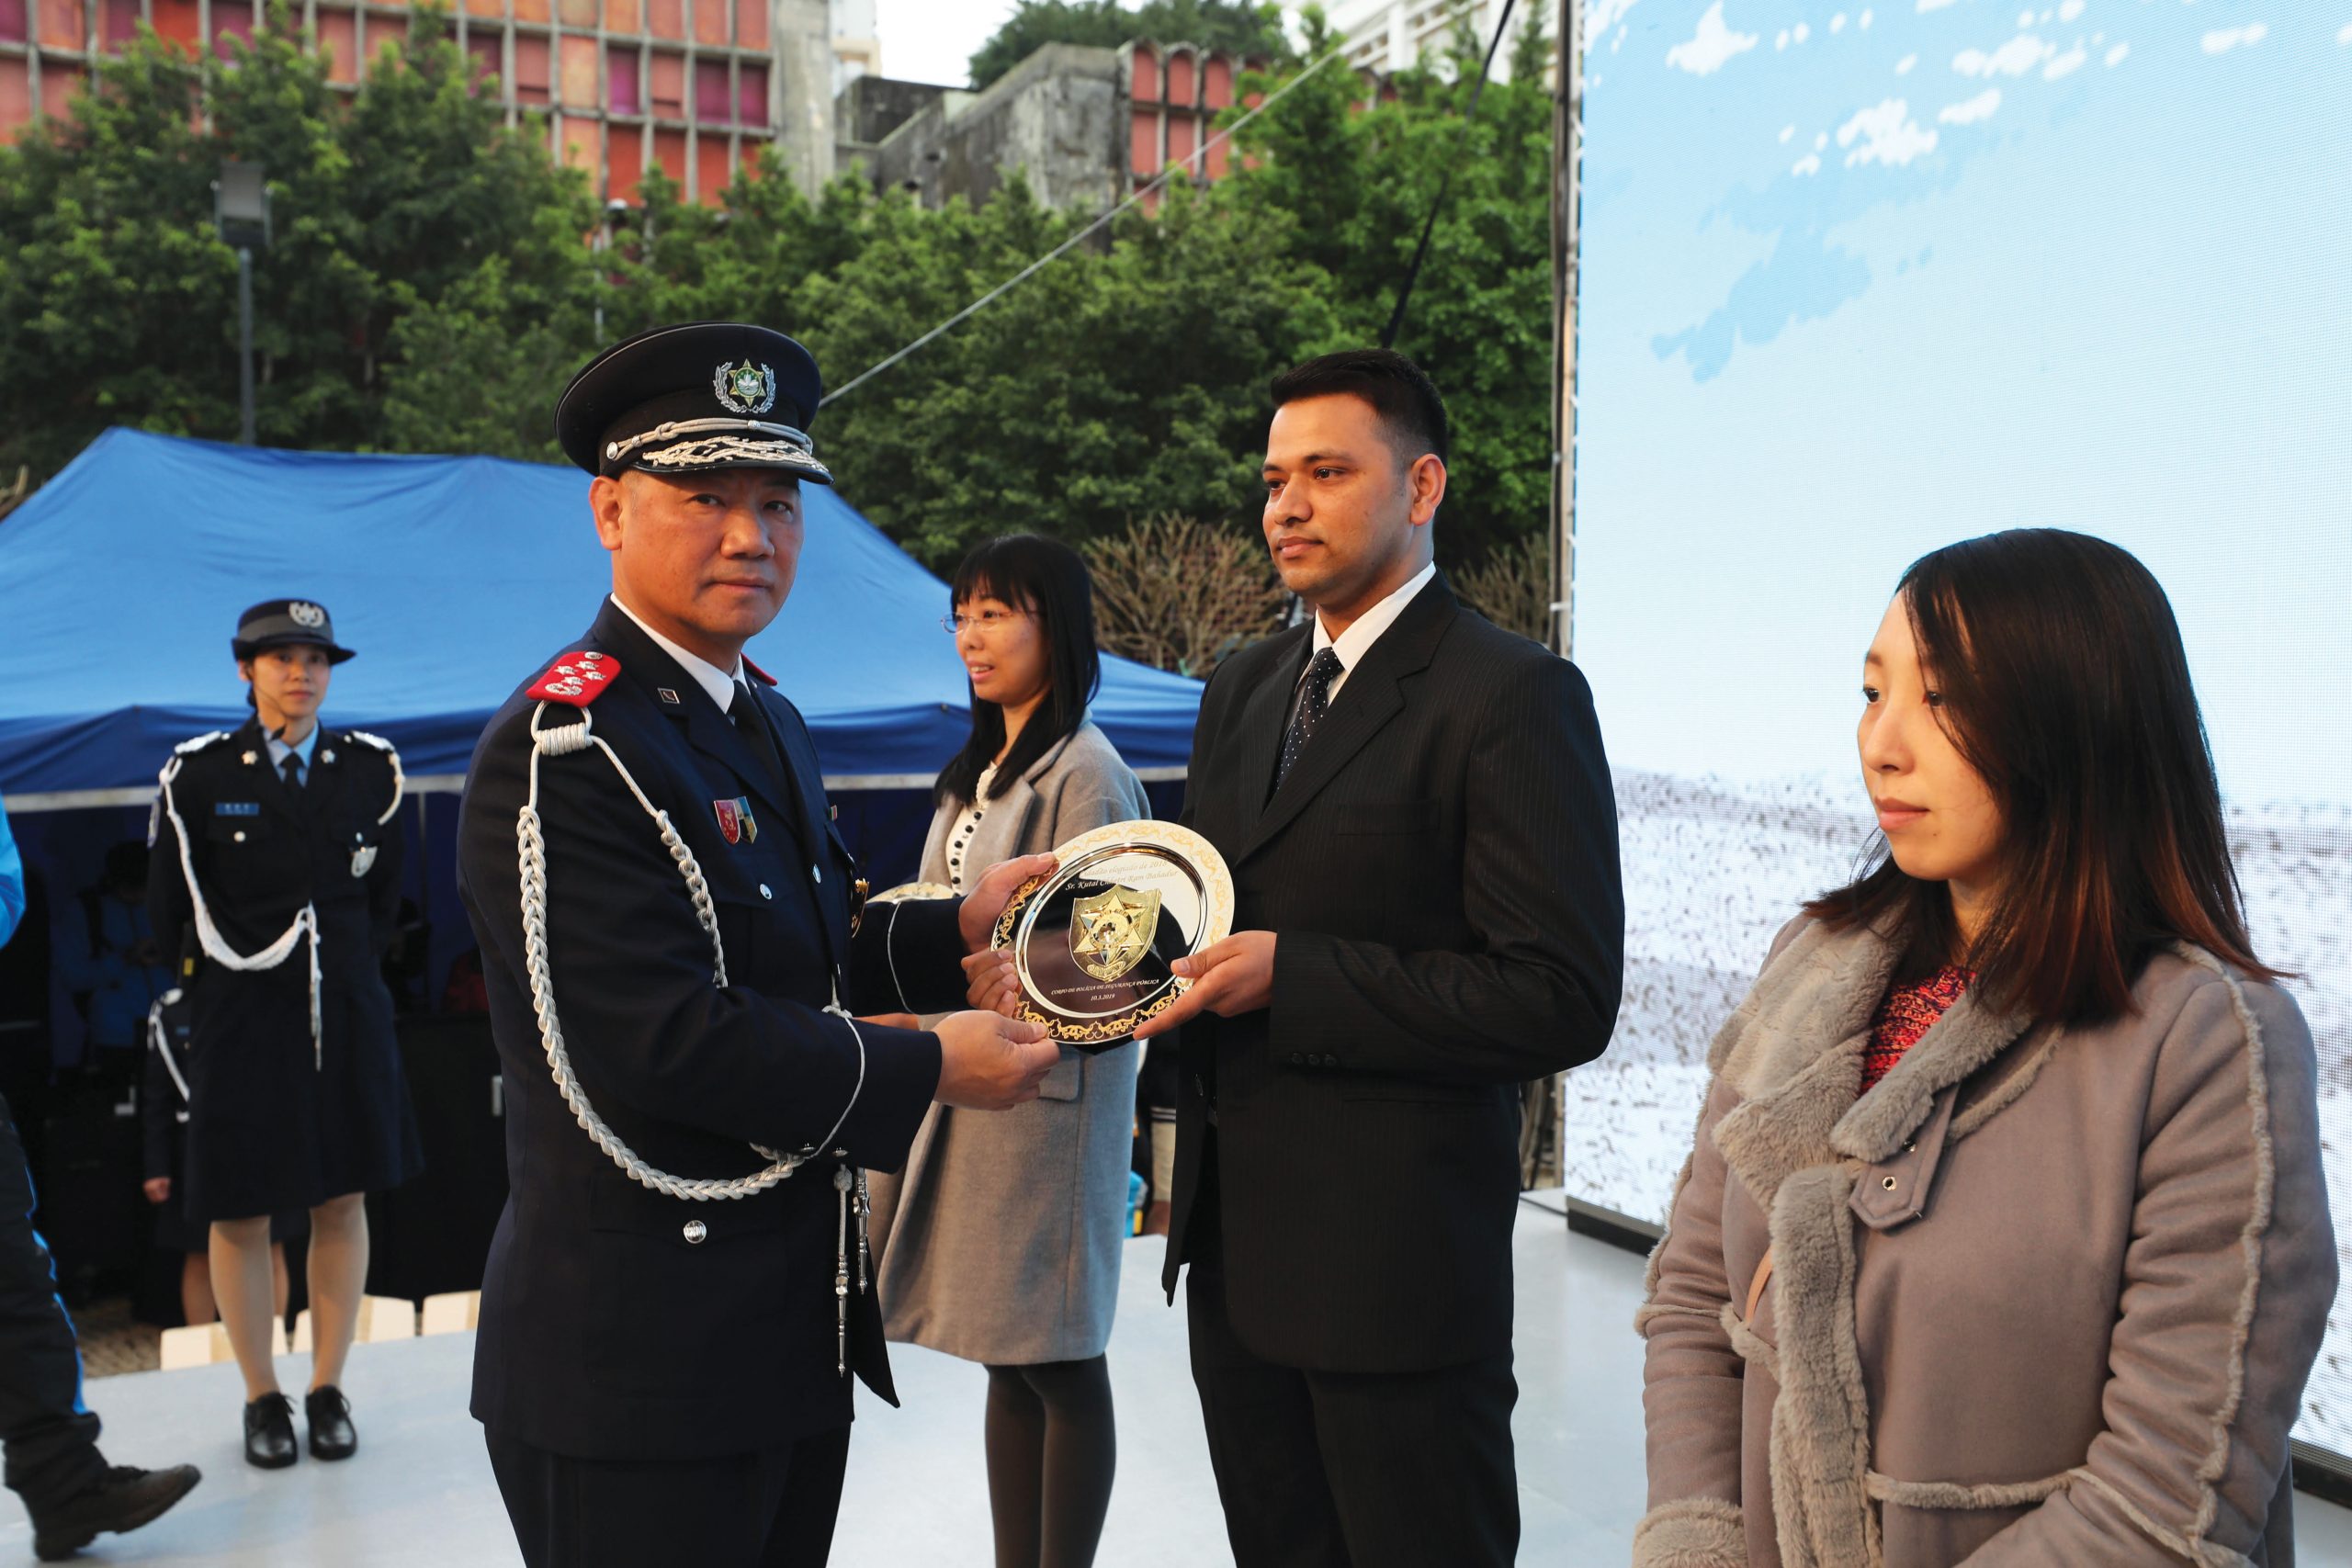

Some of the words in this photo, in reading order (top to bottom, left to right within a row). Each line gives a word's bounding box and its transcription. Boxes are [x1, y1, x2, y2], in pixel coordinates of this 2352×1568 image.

[1139, 862, 1148, 870] de
[1066, 883, 1075, 891] Sr.
[1078, 880, 1098, 889] Kutal
